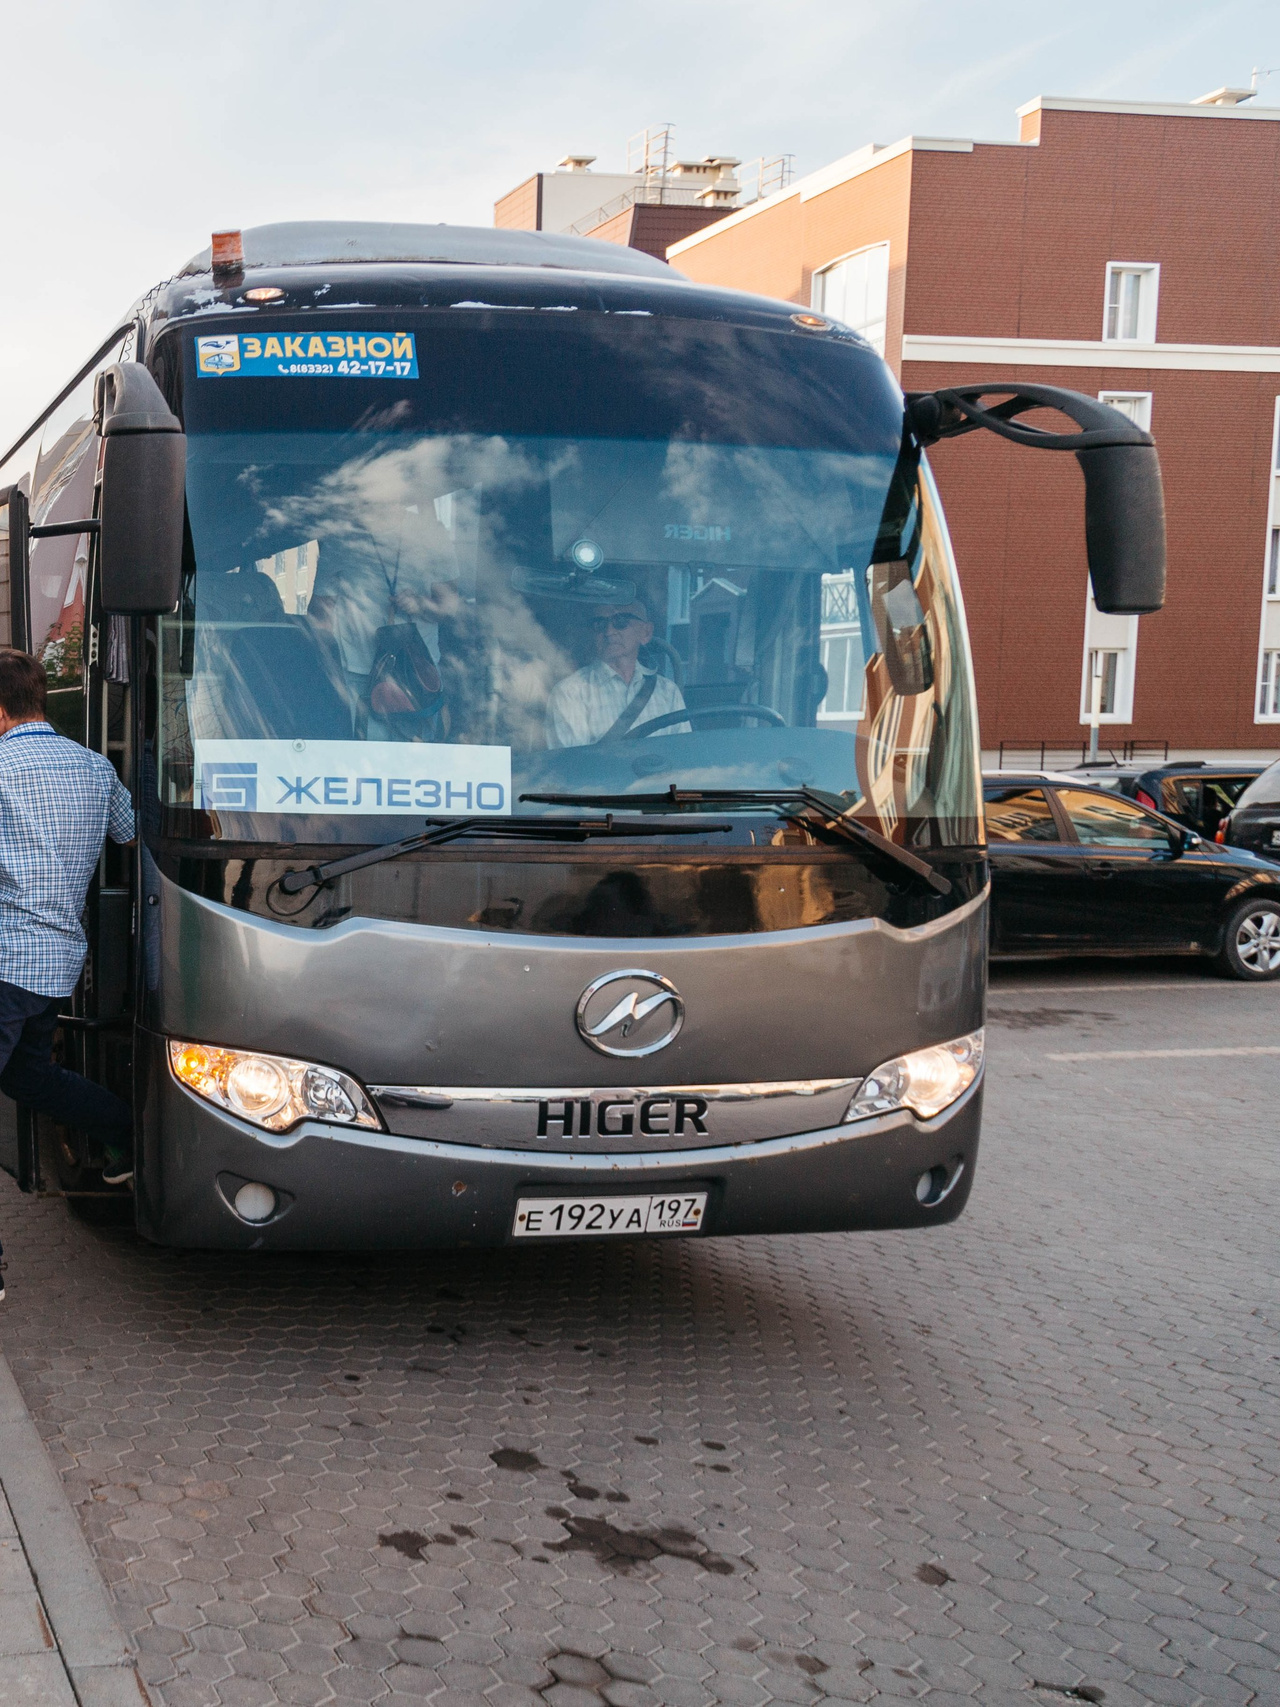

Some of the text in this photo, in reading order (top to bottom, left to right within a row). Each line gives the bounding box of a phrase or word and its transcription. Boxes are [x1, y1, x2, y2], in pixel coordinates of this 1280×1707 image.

[242, 332, 413, 359] ЗАКАЗНОЙ
[289, 360, 412, 376] 8(8332) 42-17-17
[275, 775, 506, 811] ЖЕЛЕЗНО
[536, 1098, 709, 1139] HIGER
[653, 1198, 697, 1219] 197
[659, 1219, 681, 1228] RUS
